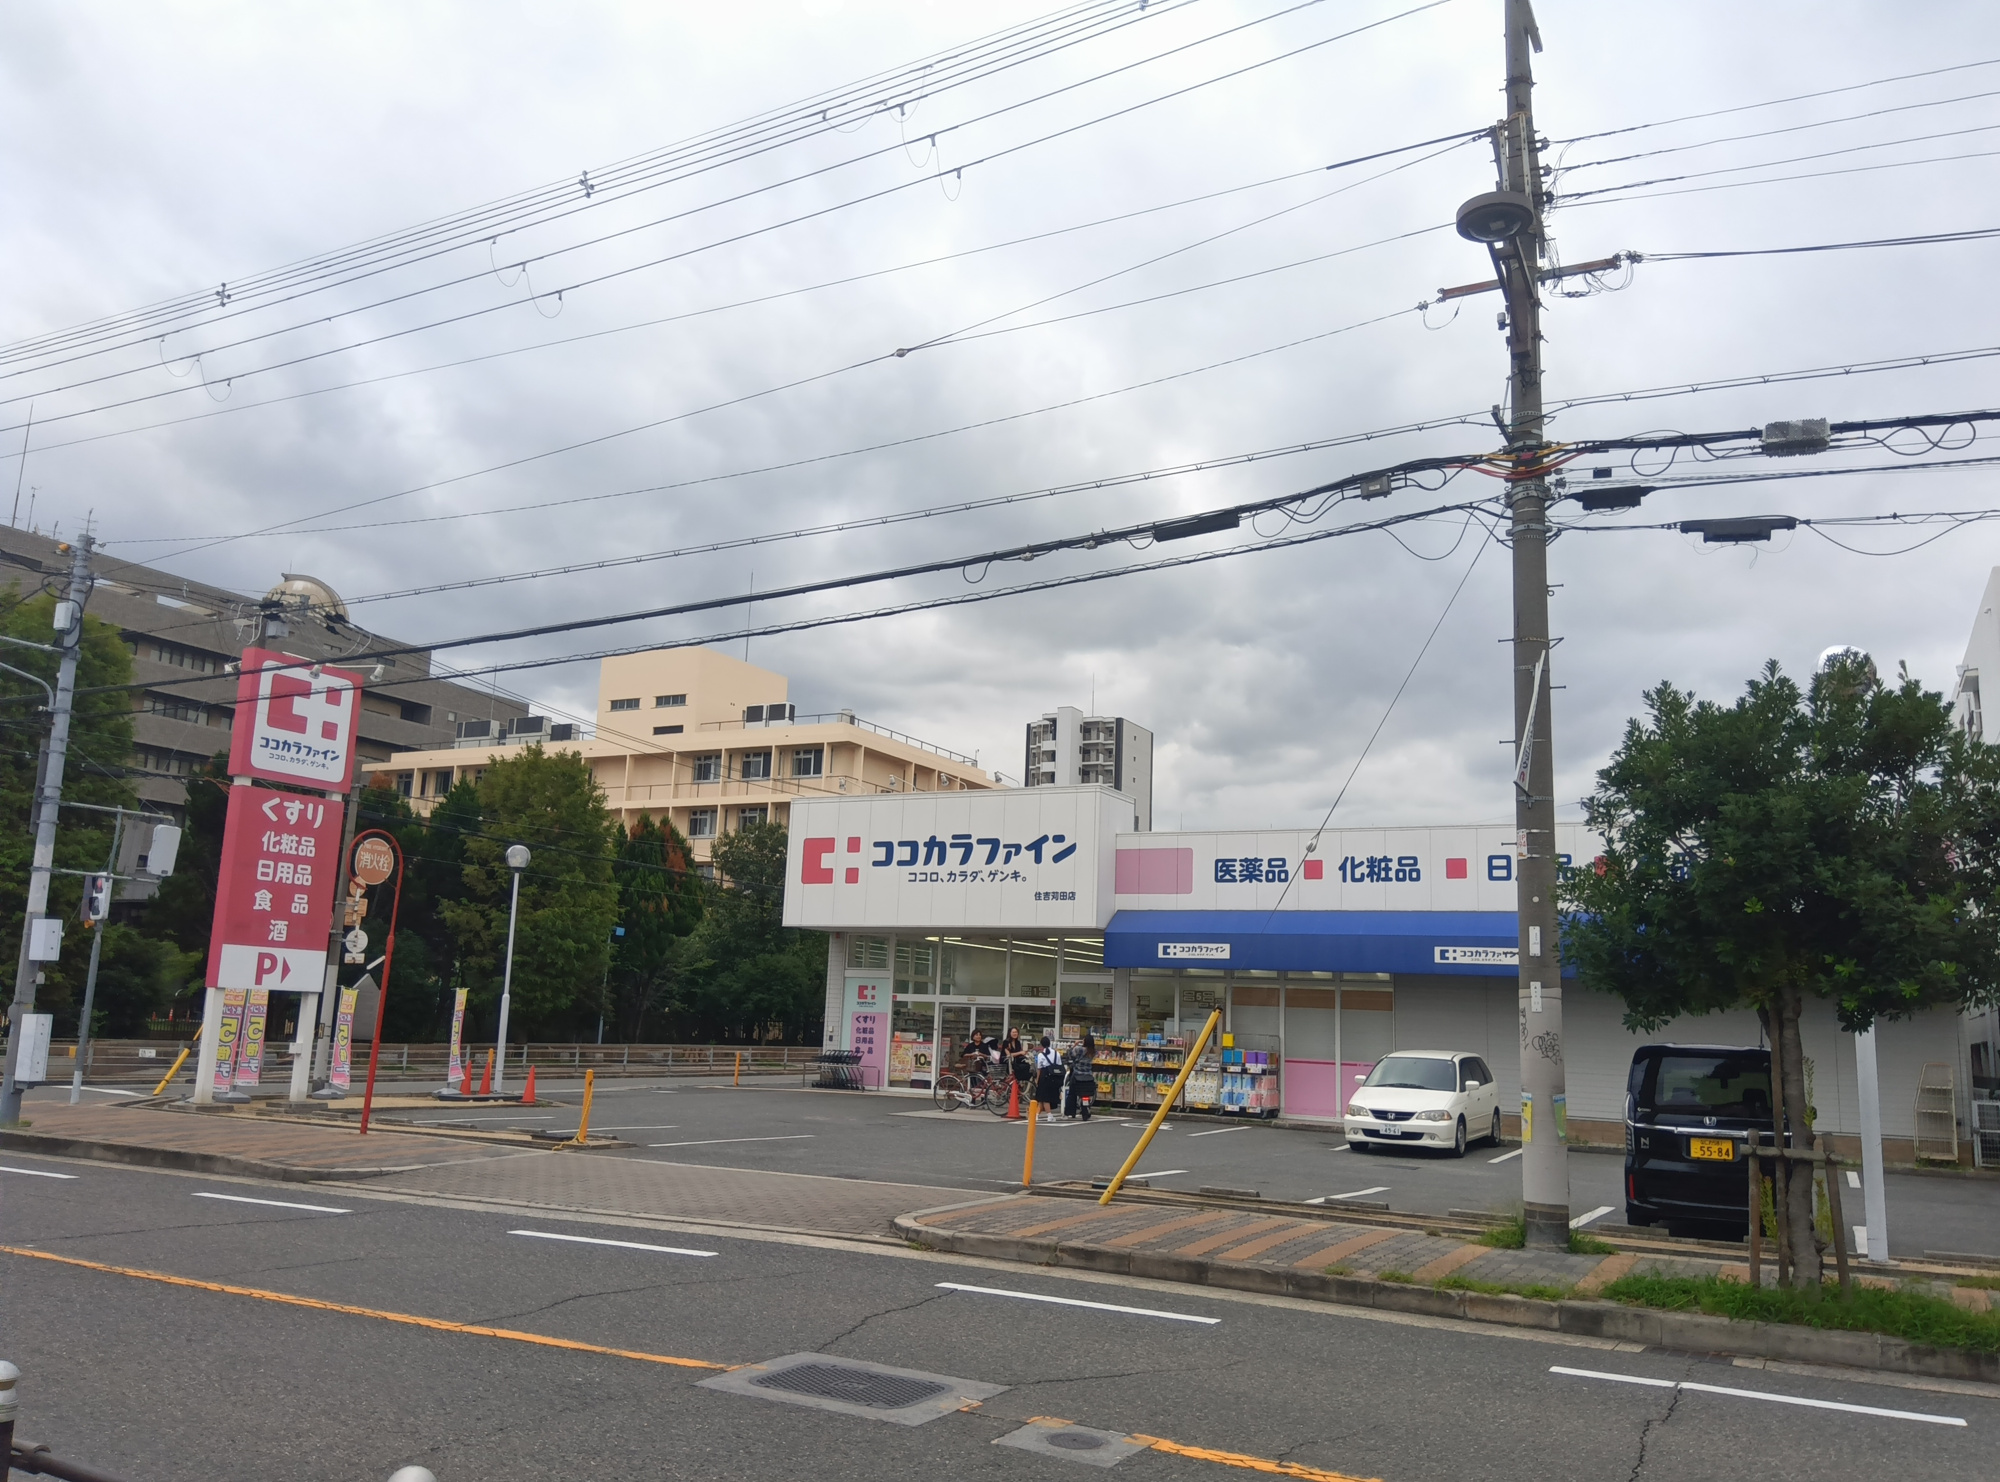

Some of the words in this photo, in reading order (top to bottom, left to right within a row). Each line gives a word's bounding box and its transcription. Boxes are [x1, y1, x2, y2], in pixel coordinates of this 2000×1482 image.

[260, 737, 340, 761] ココカラファイン
[262, 797, 324, 828] くすり
[262, 831, 316, 857] 化粧品
[872, 834, 1077, 867] ココカラファイン
[257, 859, 312, 886] 日用品
[359, 851, 389, 872] 消火栓
[1214, 857, 1289, 883] 医薬品
[1338, 855, 1421, 883] 化粧品
[908, 870, 1027, 883] ココロ、カラダ、ゲンキ。
[1034, 891, 1076, 901] 住吉苅田店
[268, 919, 289, 941] 酒
[1179, 945, 1226, 953] ココカラファイン
[1460, 949, 1517, 958] ココカラファイン
[254, 952, 278, 985] P
[855, 1015, 876, 1024] くすり
[1699, 1145, 1730, 1157] 55-84
